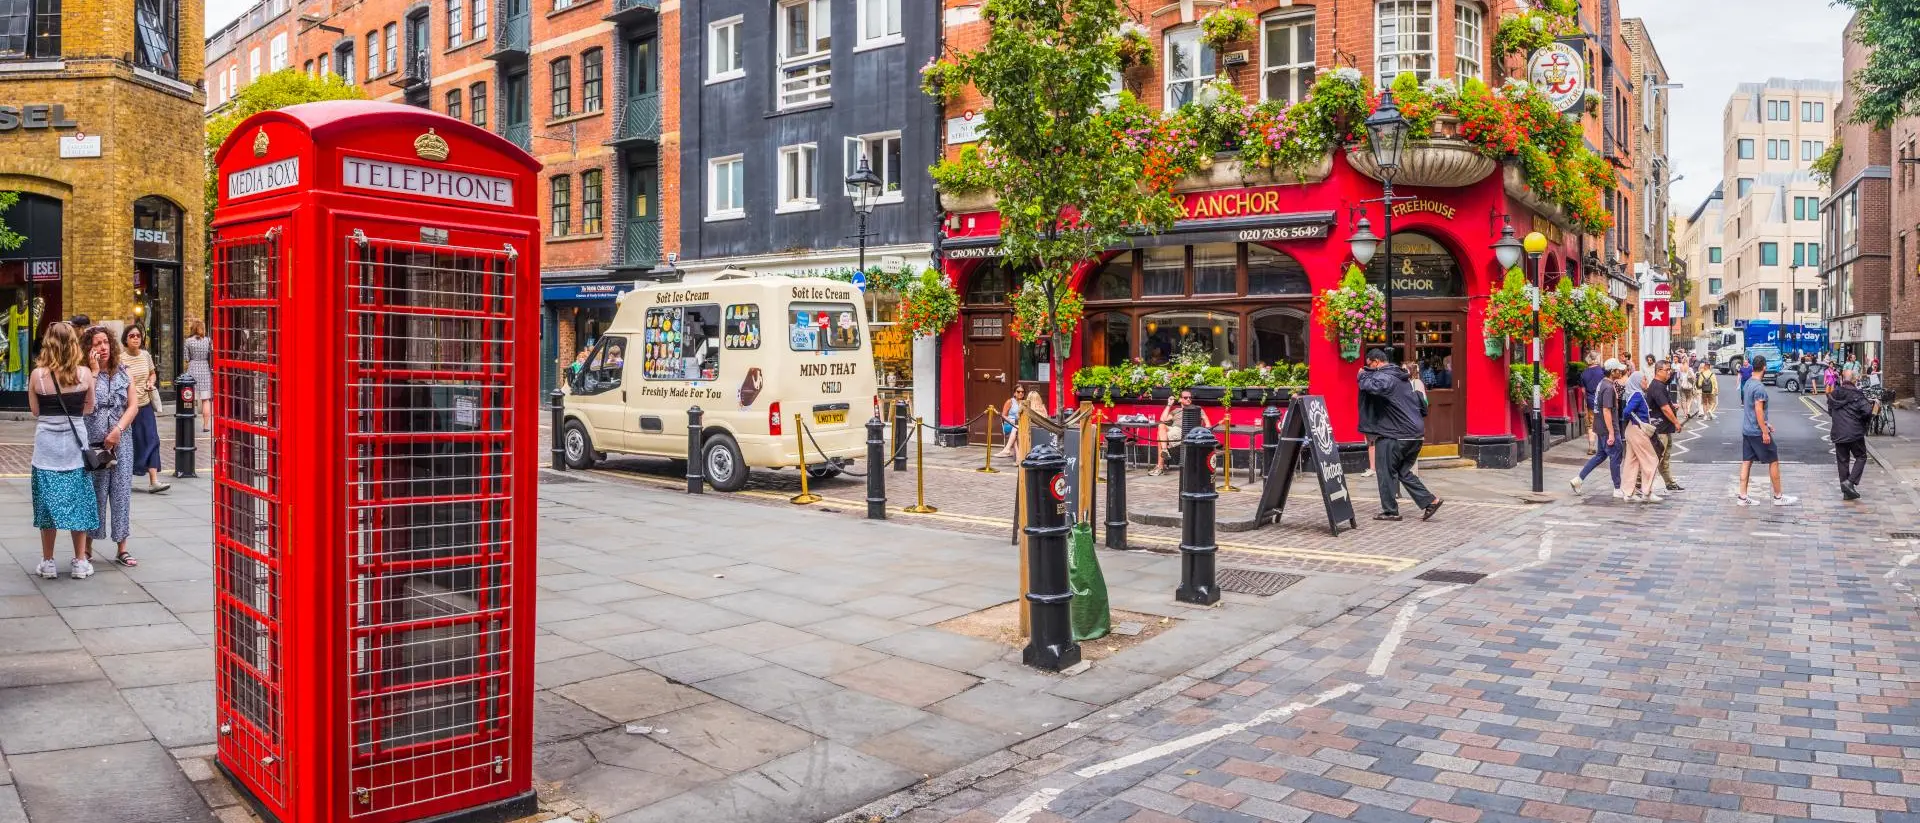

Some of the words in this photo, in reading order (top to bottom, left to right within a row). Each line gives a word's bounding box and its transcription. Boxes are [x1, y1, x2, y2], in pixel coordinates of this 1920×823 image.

[230, 170, 264, 197] MEDIA
[267, 159, 299, 189] BOXX
[349, 161, 507, 203] TELEPHONE
[1173, 194, 1190, 219] &
[1193, 190, 1281, 218] ANCHOR
[1392, 200, 1456, 220] FREEHOUSE
[134, 228, 170, 244] IESEL
[1239, 229, 1260, 241] 020
[1262, 227, 1288, 240] 7836
[1291, 226, 1319, 238] 5649
[951, 247, 986, 259] CROWN
[987, 246, 996, 257] &
[26, 261, 58, 275] IESEL
[1401, 258, 1415, 275] &
[1382, 279, 1433, 291] NCHOR
[656, 291, 671, 304] Soft
[672, 291, 683, 302] Ice
[685, 290, 710, 302] Cream
[792, 286, 810, 299] Soft
[811, 287, 823, 299] Ice
[825, 287, 850, 300] Cream
[799, 363, 828, 377] MIND
[830, 362, 857, 376] THAT
[642, 386, 669, 399] Freshly
[669, 387, 689, 398] Made
[690, 388, 704, 398] For
[706, 388, 722, 399] You
[821, 381, 842, 394] CHILD
